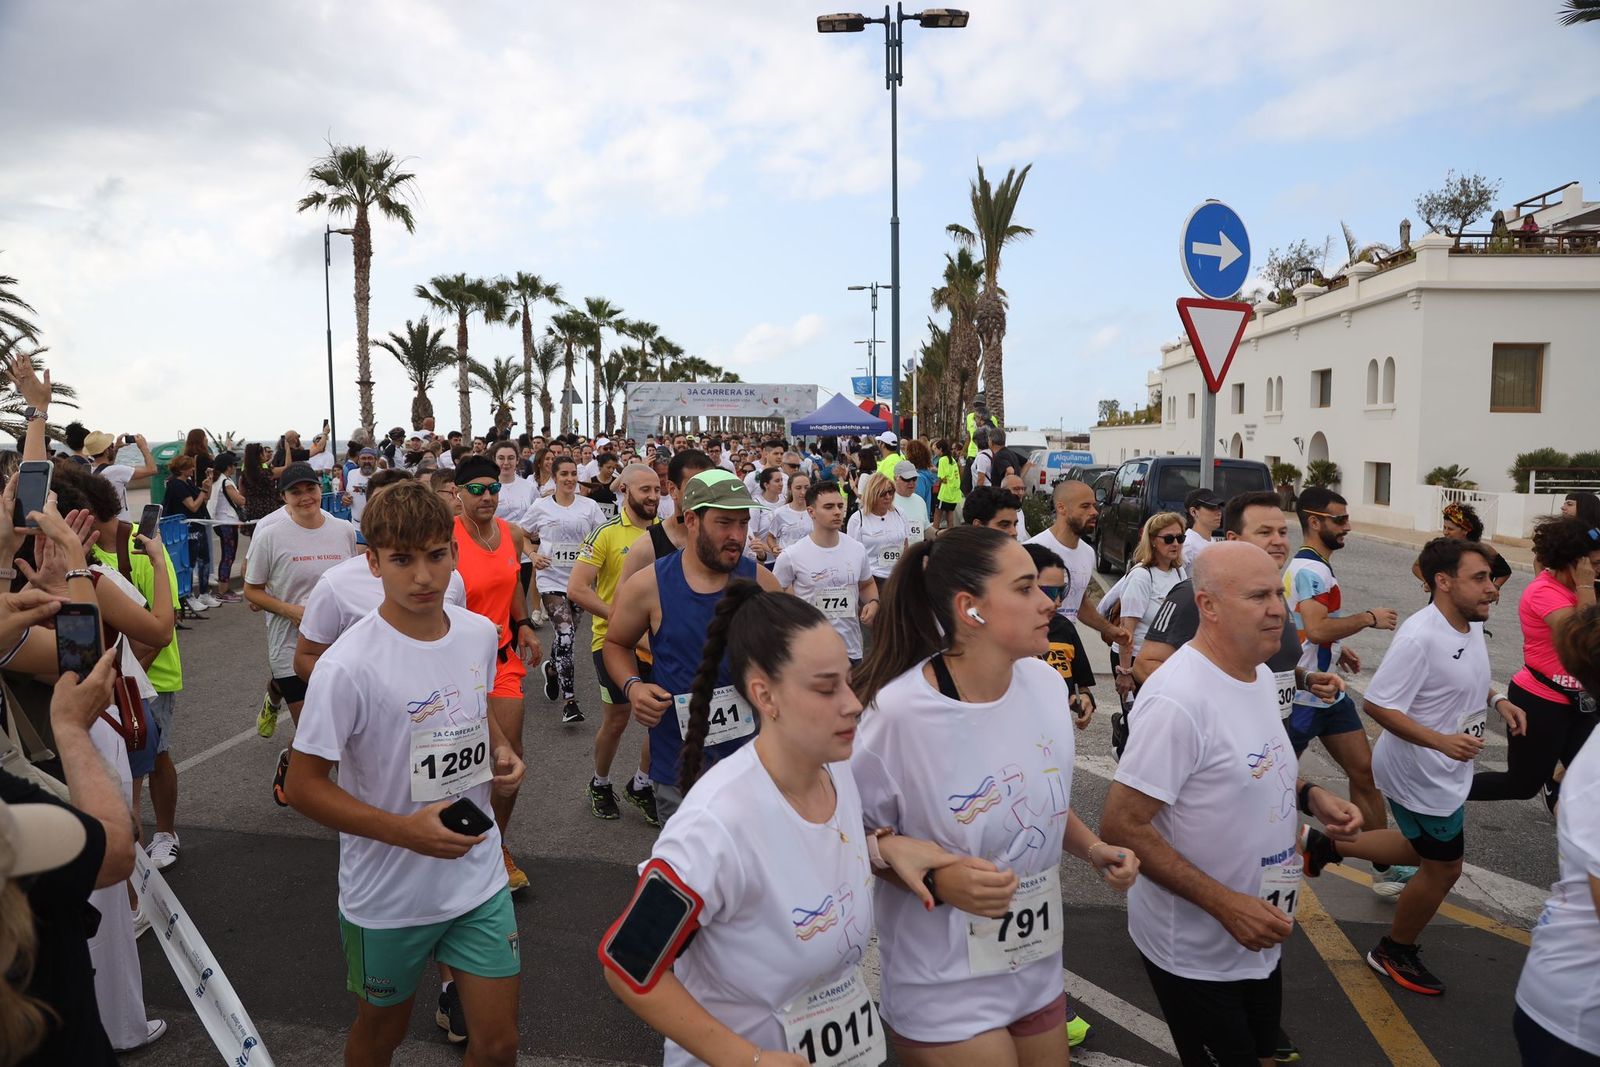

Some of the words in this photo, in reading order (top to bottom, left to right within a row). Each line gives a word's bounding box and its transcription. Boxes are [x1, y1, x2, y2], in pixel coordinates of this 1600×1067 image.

[687, 388, 698, 396] 3A
[700, 388, 742, 396] CARRERA
[744, 389, 756, 397] 5K
[822, 597, 849, 609] 774
[708, 703, 740, 726] 41
[420, 742, 486, 779] 1280
[1266, 888, 1298, 913] 11
[997, 901, 1050, 942] 791
[798, 999, 873, 1066] 1017
